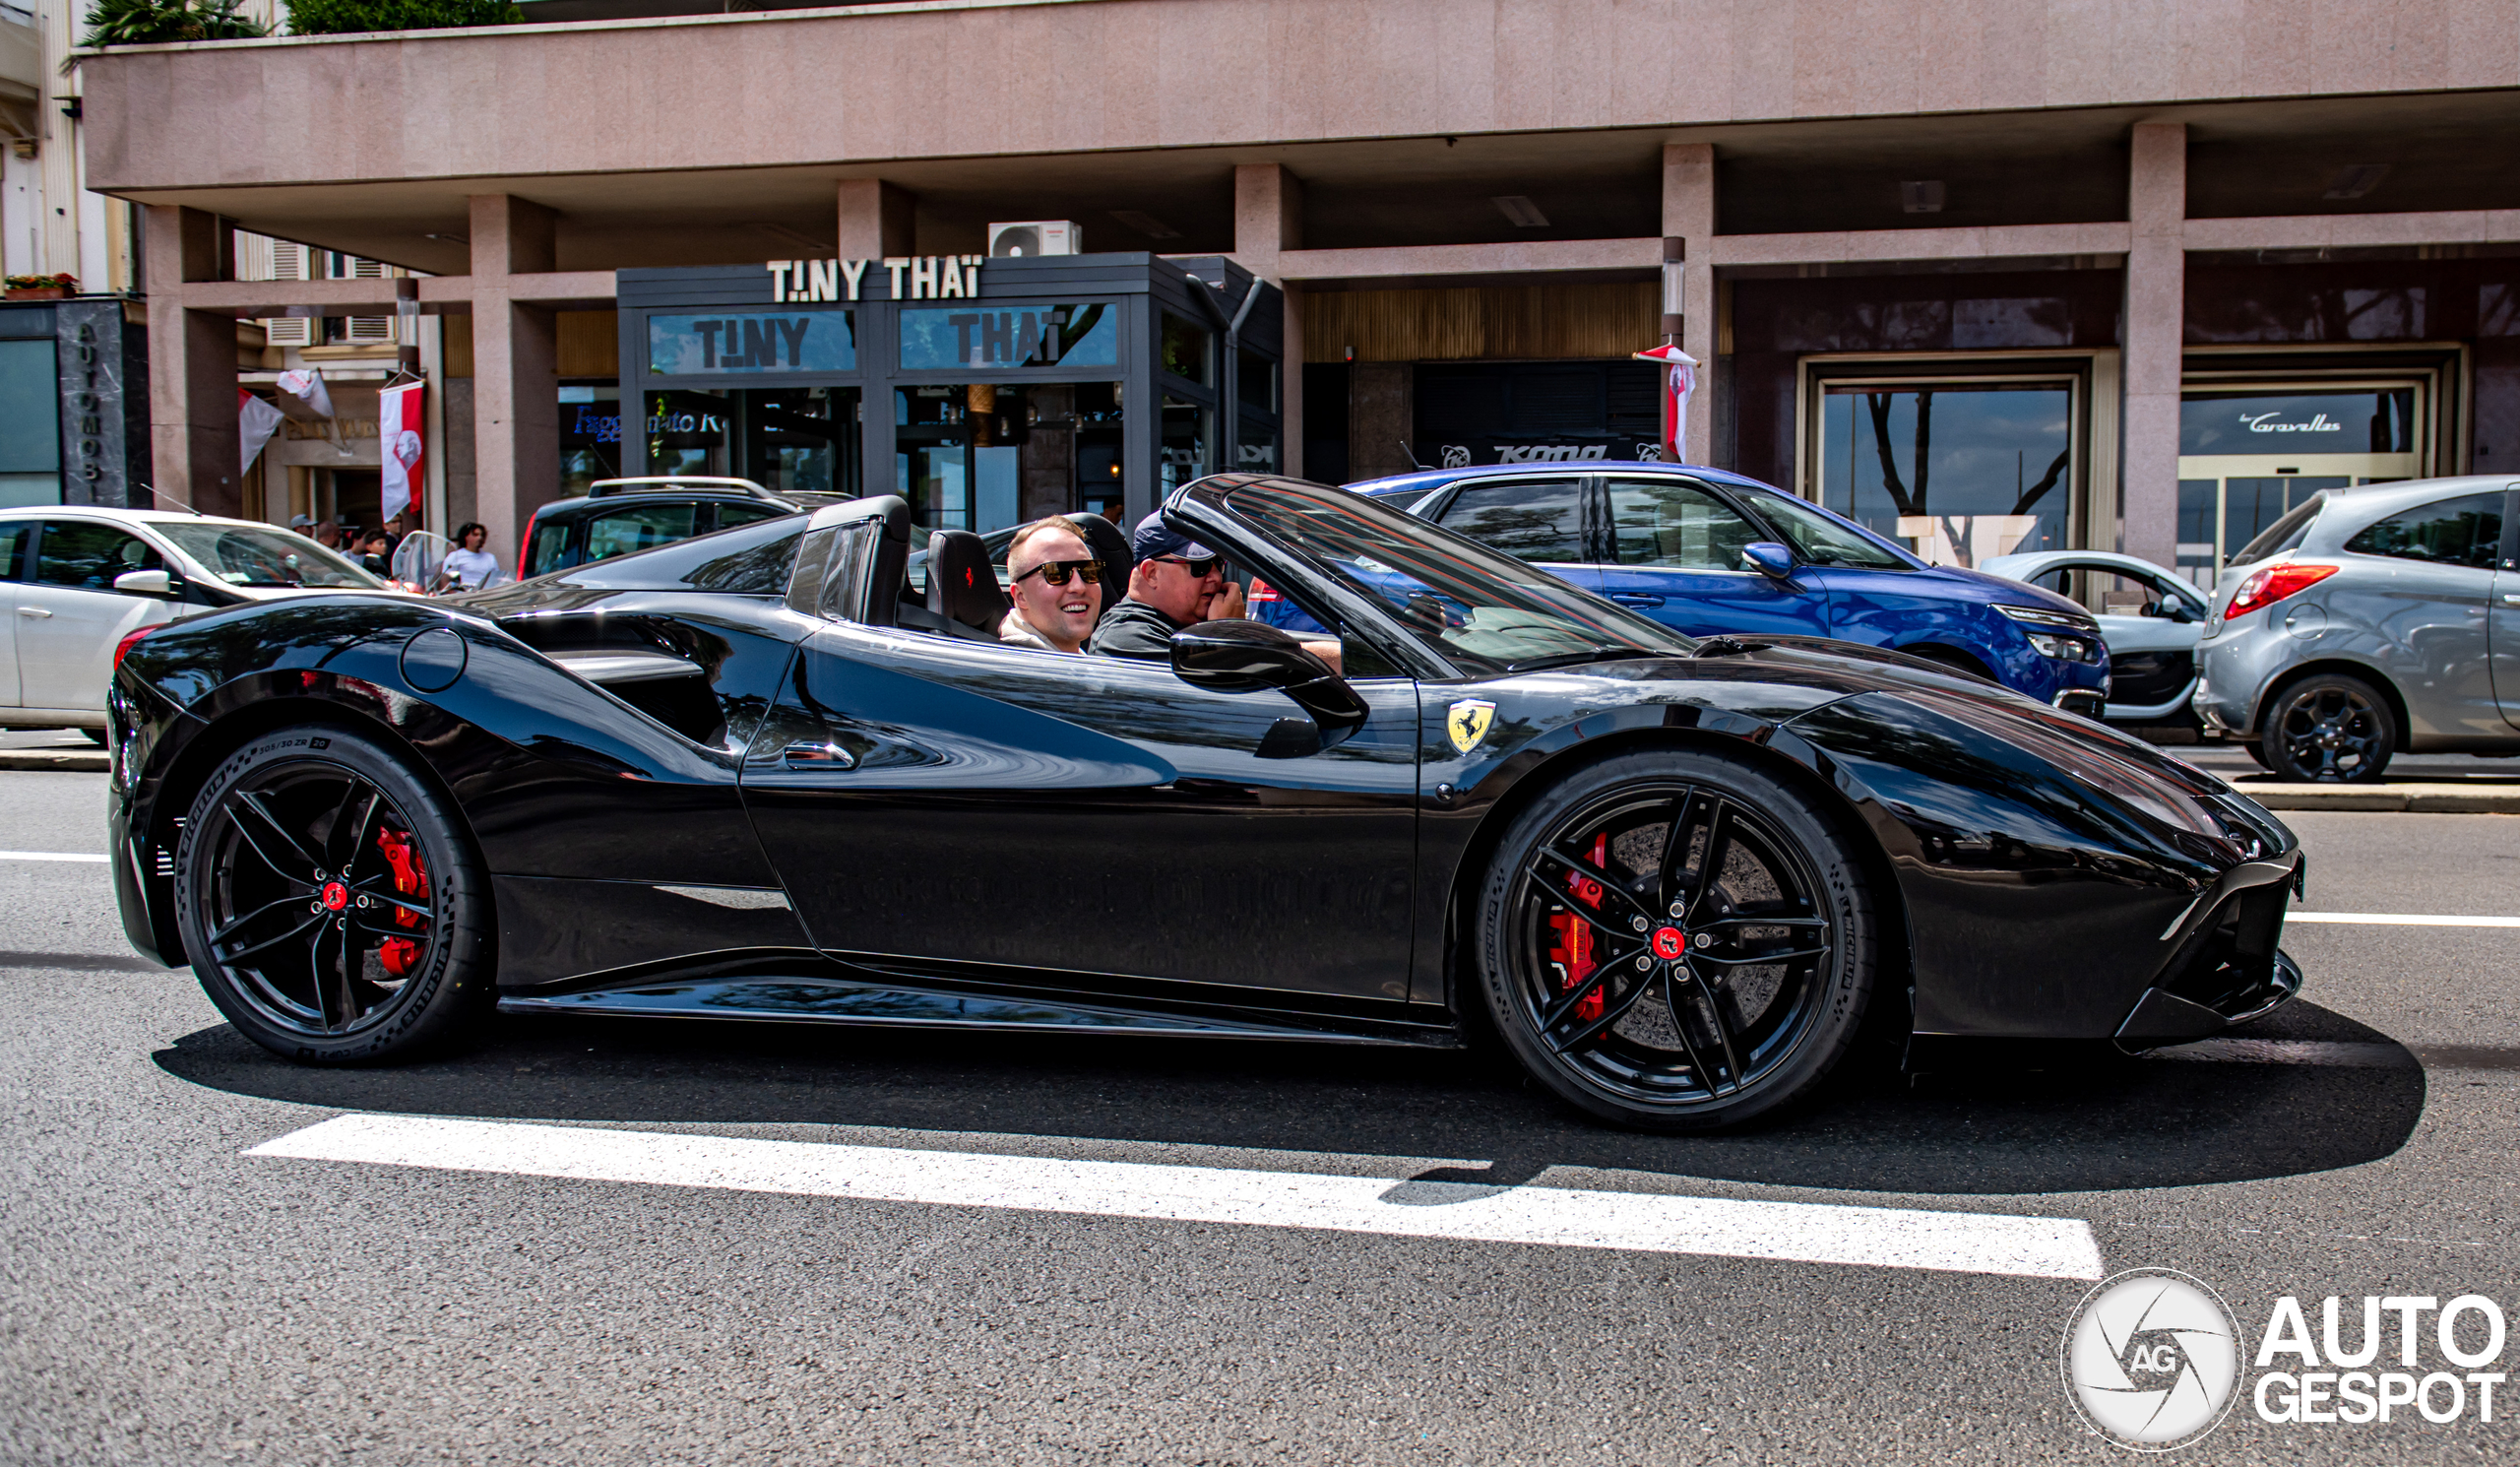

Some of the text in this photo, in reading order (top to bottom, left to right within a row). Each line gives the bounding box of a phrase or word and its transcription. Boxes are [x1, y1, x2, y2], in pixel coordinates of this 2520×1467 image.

[883, 254, 983, 300] THAÏ
[948, 310, 1067, 363] THAÏ
[259, 739, 293, 755] 305/30
[181, 774, 226, 854] MICHELIN
[1486, 901, 1498, 972] MICHELIN
[1844, 917, 1856, 989] MICHELIN
[405, 946, 449, 1026] MICHELIN
